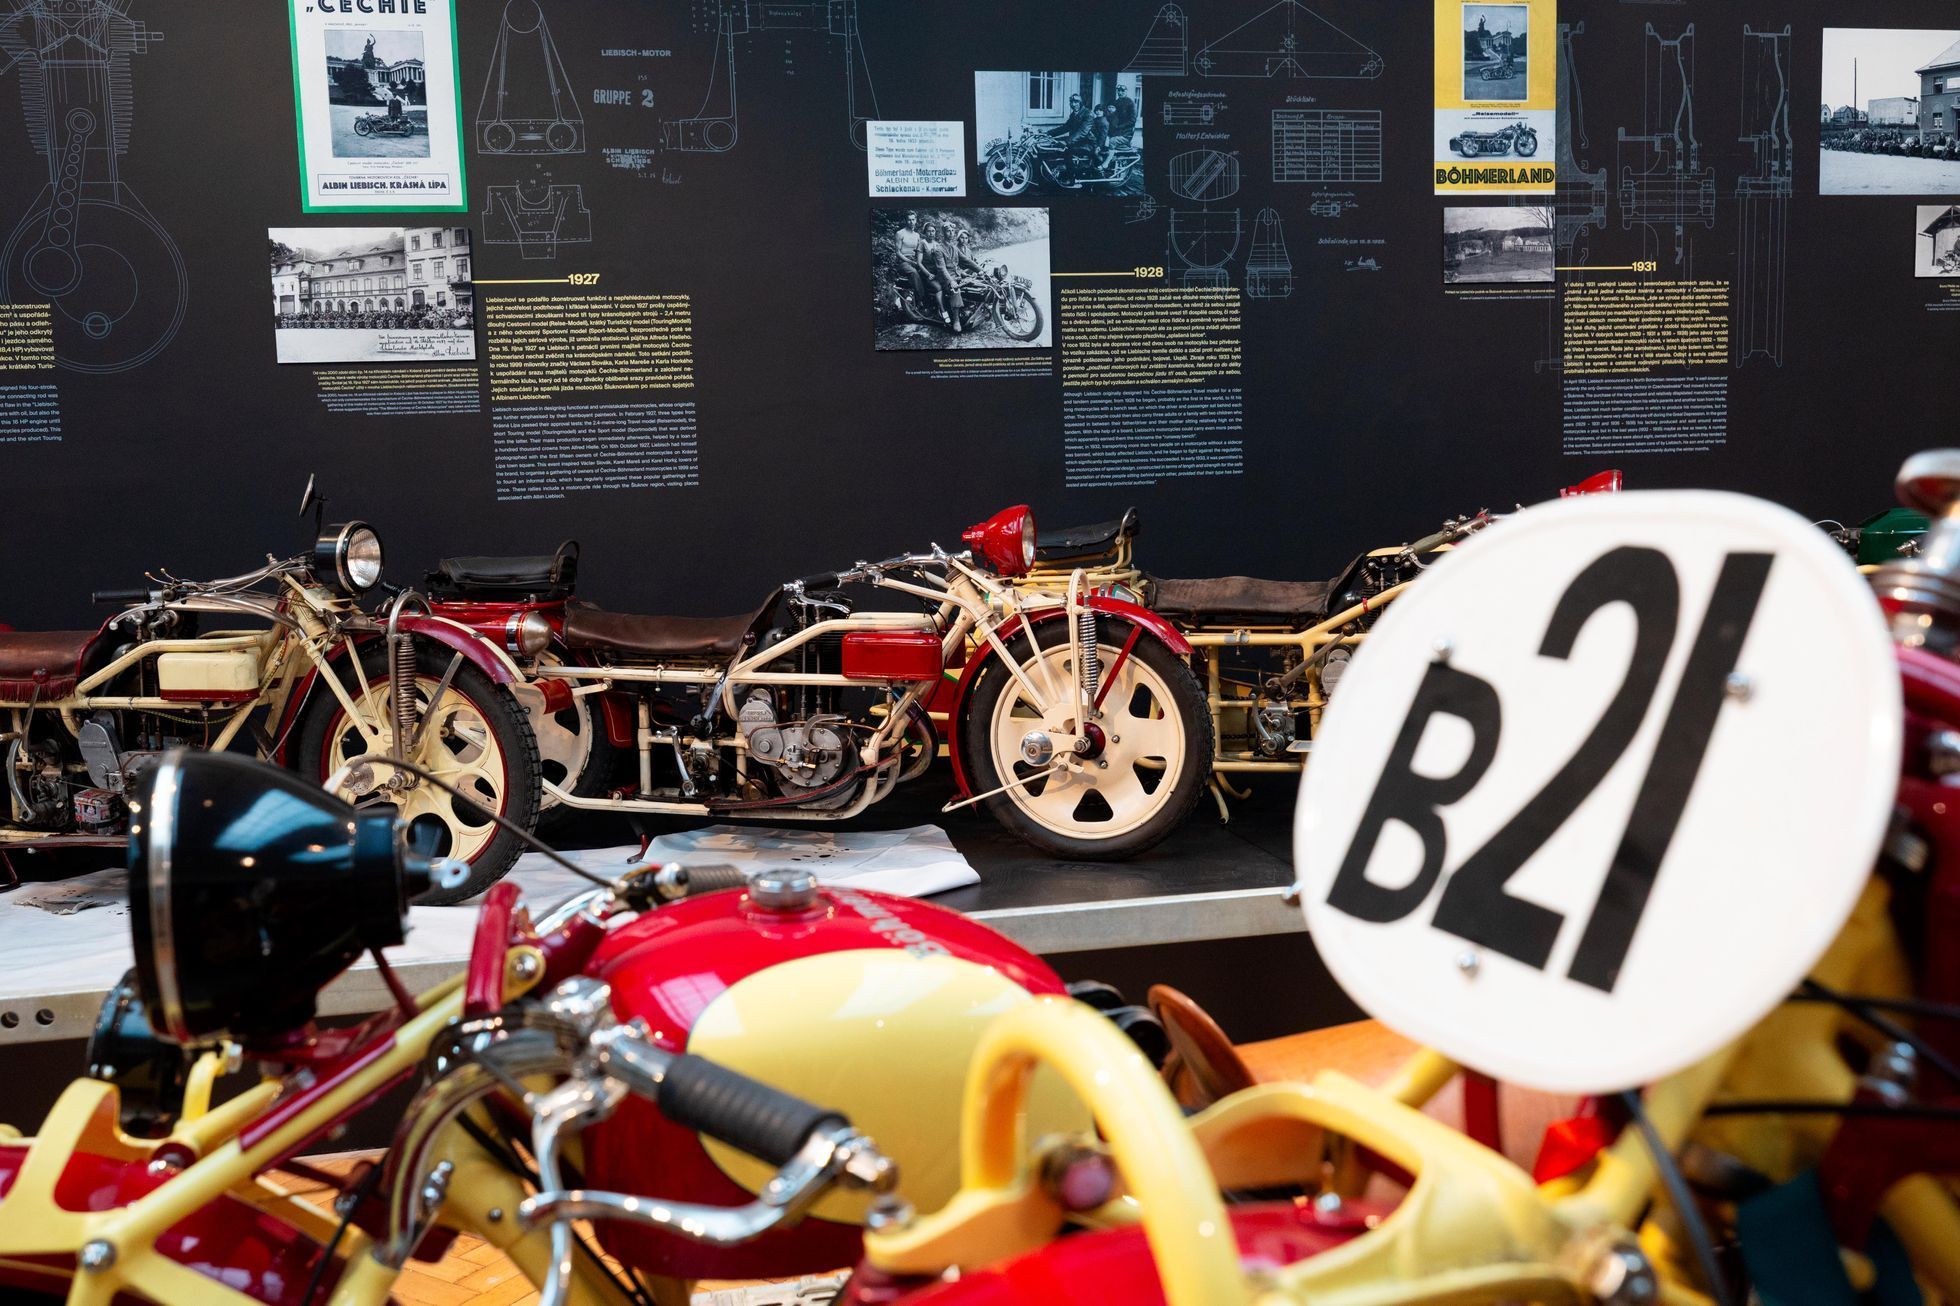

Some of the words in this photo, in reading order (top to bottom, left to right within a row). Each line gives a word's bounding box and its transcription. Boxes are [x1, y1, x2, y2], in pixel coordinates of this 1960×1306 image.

[593, 88, 632, 106] GRUPPE
[642, 88, 654, 108] 2
[1436, 166, 1554, 184] BÖHMERLAND
[322, 181, 348, 190] ALBIN
[390, 180, 426, 189] KRÁSNÁ
[428, 180, 446, 188] LÍPA
[1134, 266, 1164, 278] 1928
[1632, 262, 1657, 272] 1931
[568, 273, 600, 285] 1927
